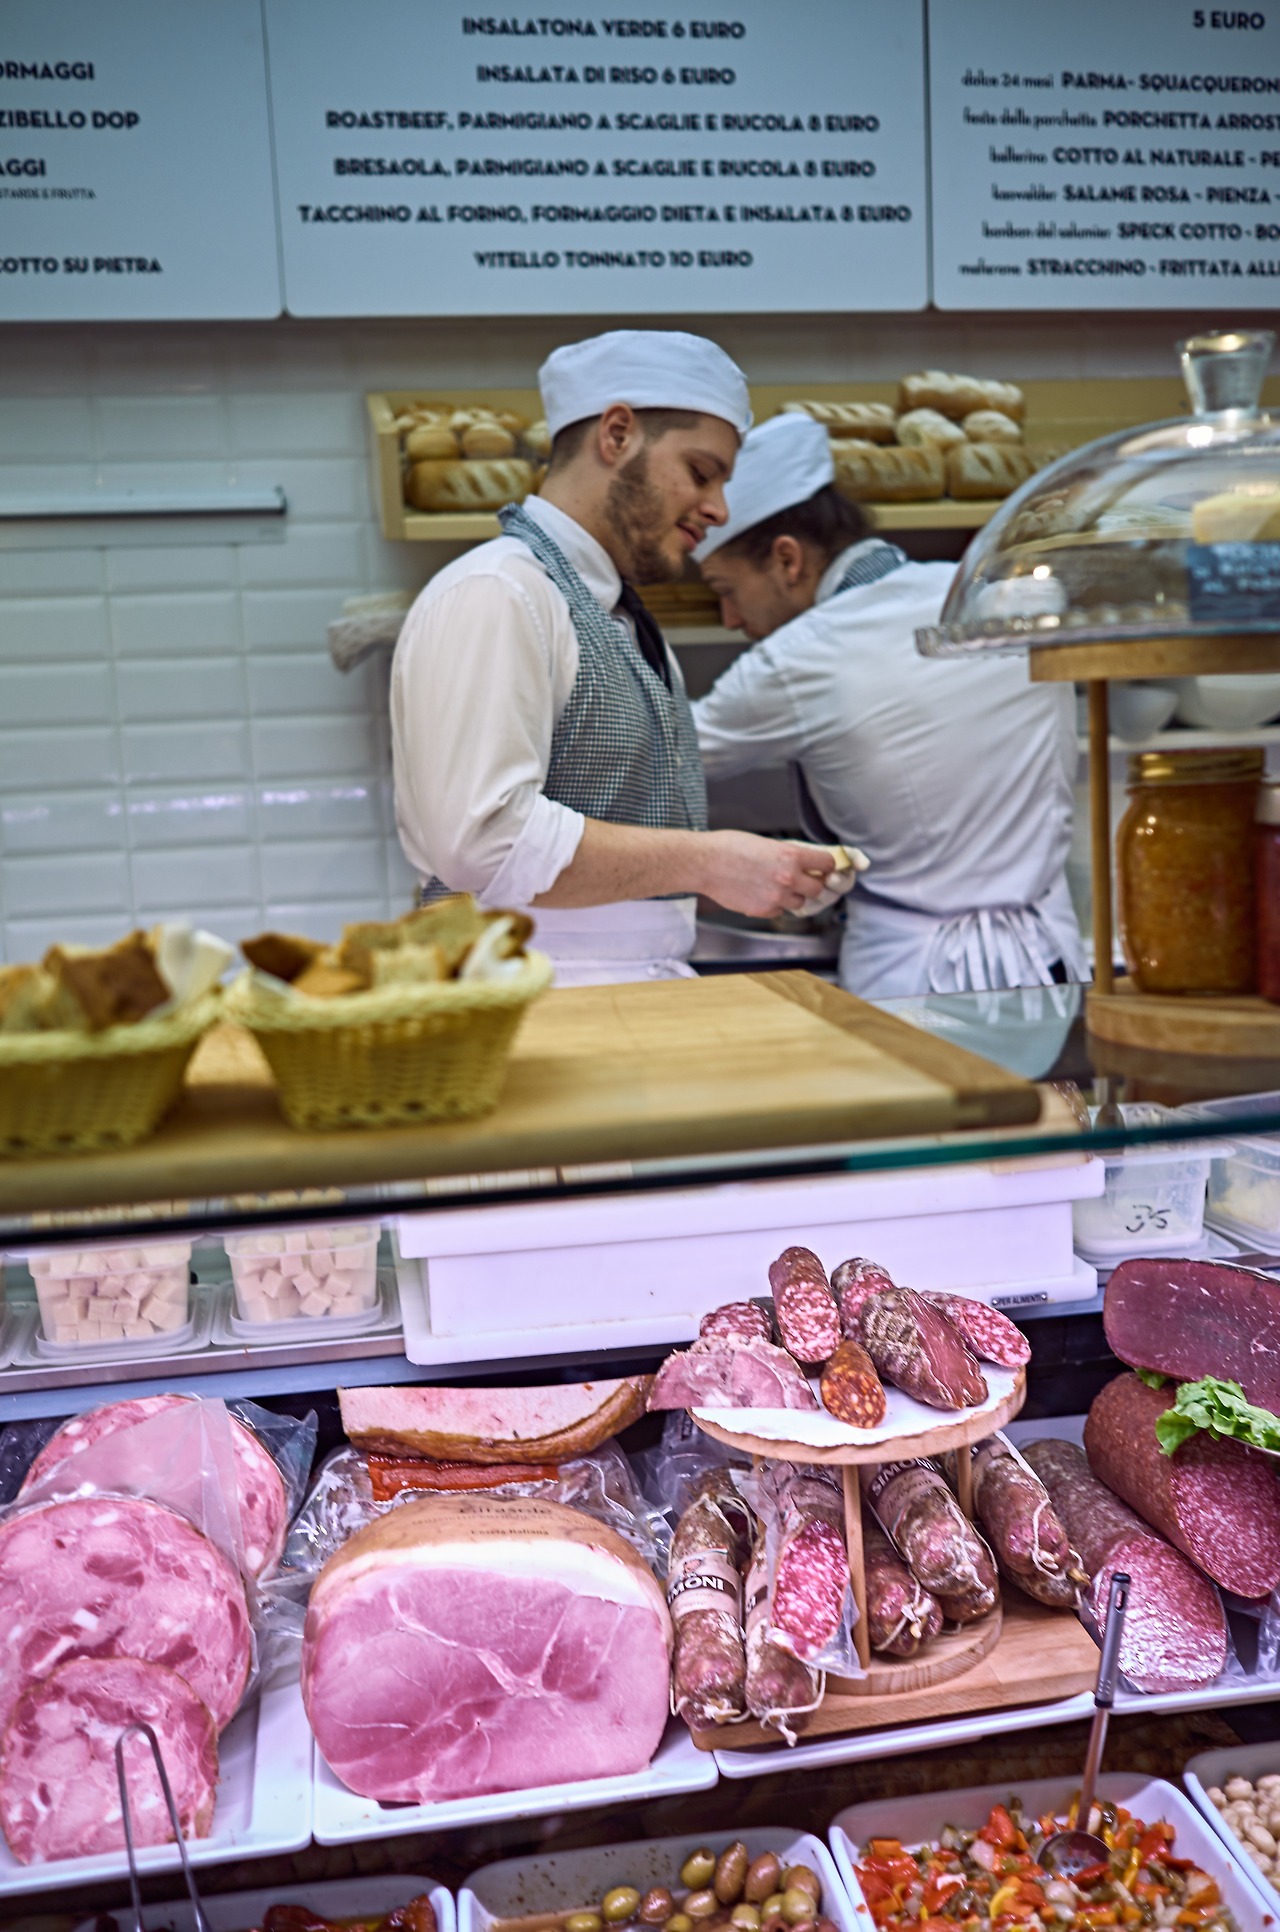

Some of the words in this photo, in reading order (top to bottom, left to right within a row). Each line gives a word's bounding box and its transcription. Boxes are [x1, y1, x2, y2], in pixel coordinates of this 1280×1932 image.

[462, 16, 598, 37] INSALATONA
[601, 19, 668, 38] VERDE
[671, 20, 686, 39] 6
[689, 20, 746, 40] EURO
[1193, 10, 1205, 28] 5
[1210, 11, 1265, 30] EURO
[476, 64, 580, 84] INSALATA
[582, 65, 606, 84] DI
[609, 66, 659, 85] RISO
[661, 67, 676, 85] 6
[679, 67, 736, 86] EURO
[1001, 71, 1020, 88] 24
[91, 110, 140, 130] DOP
[325, 110, 455, 132] ROASTBEEF,
[457, 112, 593, 131] PARMIGIANO
[595, 113, 613, 131] A
[615, 112, 702, 131] SCAGLIE
[704, 114, 718, 132] E
[721, 113, 805, 132] RUCOLA
[807, 115, 823, 133] 8
[824, 115, 880, 133] EURO
[1102, 110, 1213, 130] PORCHETTA
[1052, 146, 1119, 165] COTTO
[1121, 148, 1146, 166] AL
[1149, 149, 1245, 168] NATURALE
[333, 157, 452, 178] BRESAOLA,
[454, 158, 590, 177] PARMIGIANO
[592, 160, 610, 177] A
[612, 158, 698, 178] SCAGLIE
[701, 160, 715, 178] E
[718, 160, 801, 178] RUCOLA
[804, 161, 818, 178] 8
[820, 160, 876, 178] EURO
[1063, 184, 1137, 203] SALAME
[1140, 185, 1191, 203] ROSA
[1206, 186, 1271, 204] PIENZA
[297, 204, 412, 224] TACCHINO
[415, 204, 444, 224] AL
[446, 205, 528, 225] FORNO,
[530, 205, 658, 224] FORMAGGIO
[660, 206, 720, 224] DIETA
[723, 206, 737, 224] E
[740, 206, 838, 224] INSALATA
[840, 207, 854, 224] 8
[857, 206, 912, 224] EURO
[1117, 222, 1177, 241] SPECK
[1178, 222, 1243, 241] COTTO
[62, 257, 89, 274] SU
[92, 256, 163, 274] PIETRA
[473, 250, 561, 269] VITELLO
[563, 250, 666, 269] TONNATO
[669, 251, 694, 269] 10
[696, 250, 754, 269] EURO
[1026, 258, 1148, 277] STRACCHINO
[1158, 259, 1243, 277] FRITTATA
